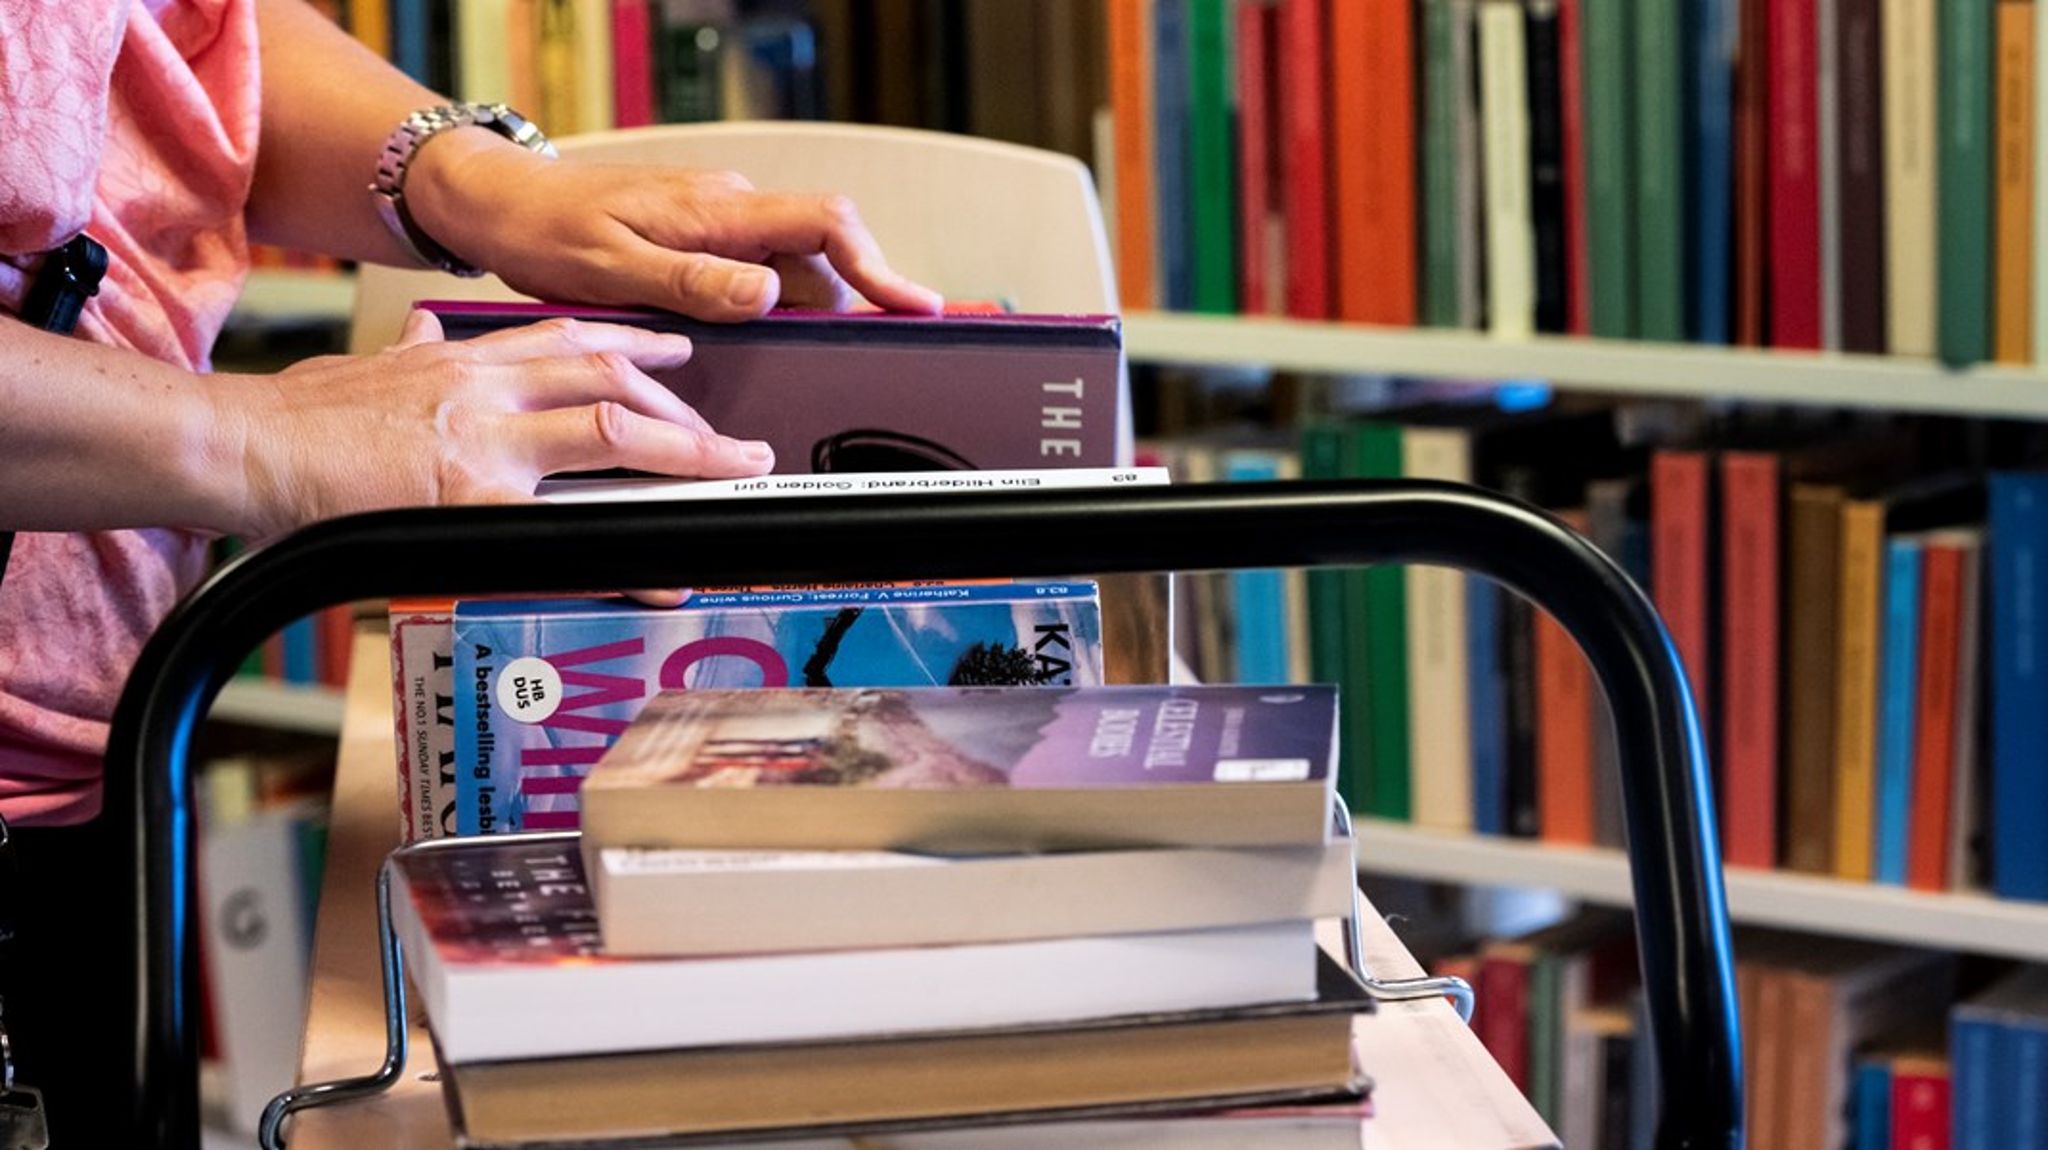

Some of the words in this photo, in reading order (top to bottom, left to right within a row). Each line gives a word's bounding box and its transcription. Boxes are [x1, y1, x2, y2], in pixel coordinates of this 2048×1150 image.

[1041, 377, 1083, 457] THE
[734, 481, 769, 491] girl
[776, 481, 853, 490] Golden
[862, 479, 993, 489] Hilderbrand:
[1000, 478, 1041, 487] Elin
[700, 596, 737, 604] wine
[742, 594, 804, 603] Curious
[893, 589, 970, 599] Katherine
[475, 643, 493, 660] A
[1034, 623, 1071, 685] KA
[414, 676, 426, 698] THE
[513, 676, 531, 709] DUS
[530, 679, 545, 701] HB
[474, 666, 496, 779] bestselling
[416, 729, 430, 776] SUNDAY
[420, 780, 432, 812] TIMES
